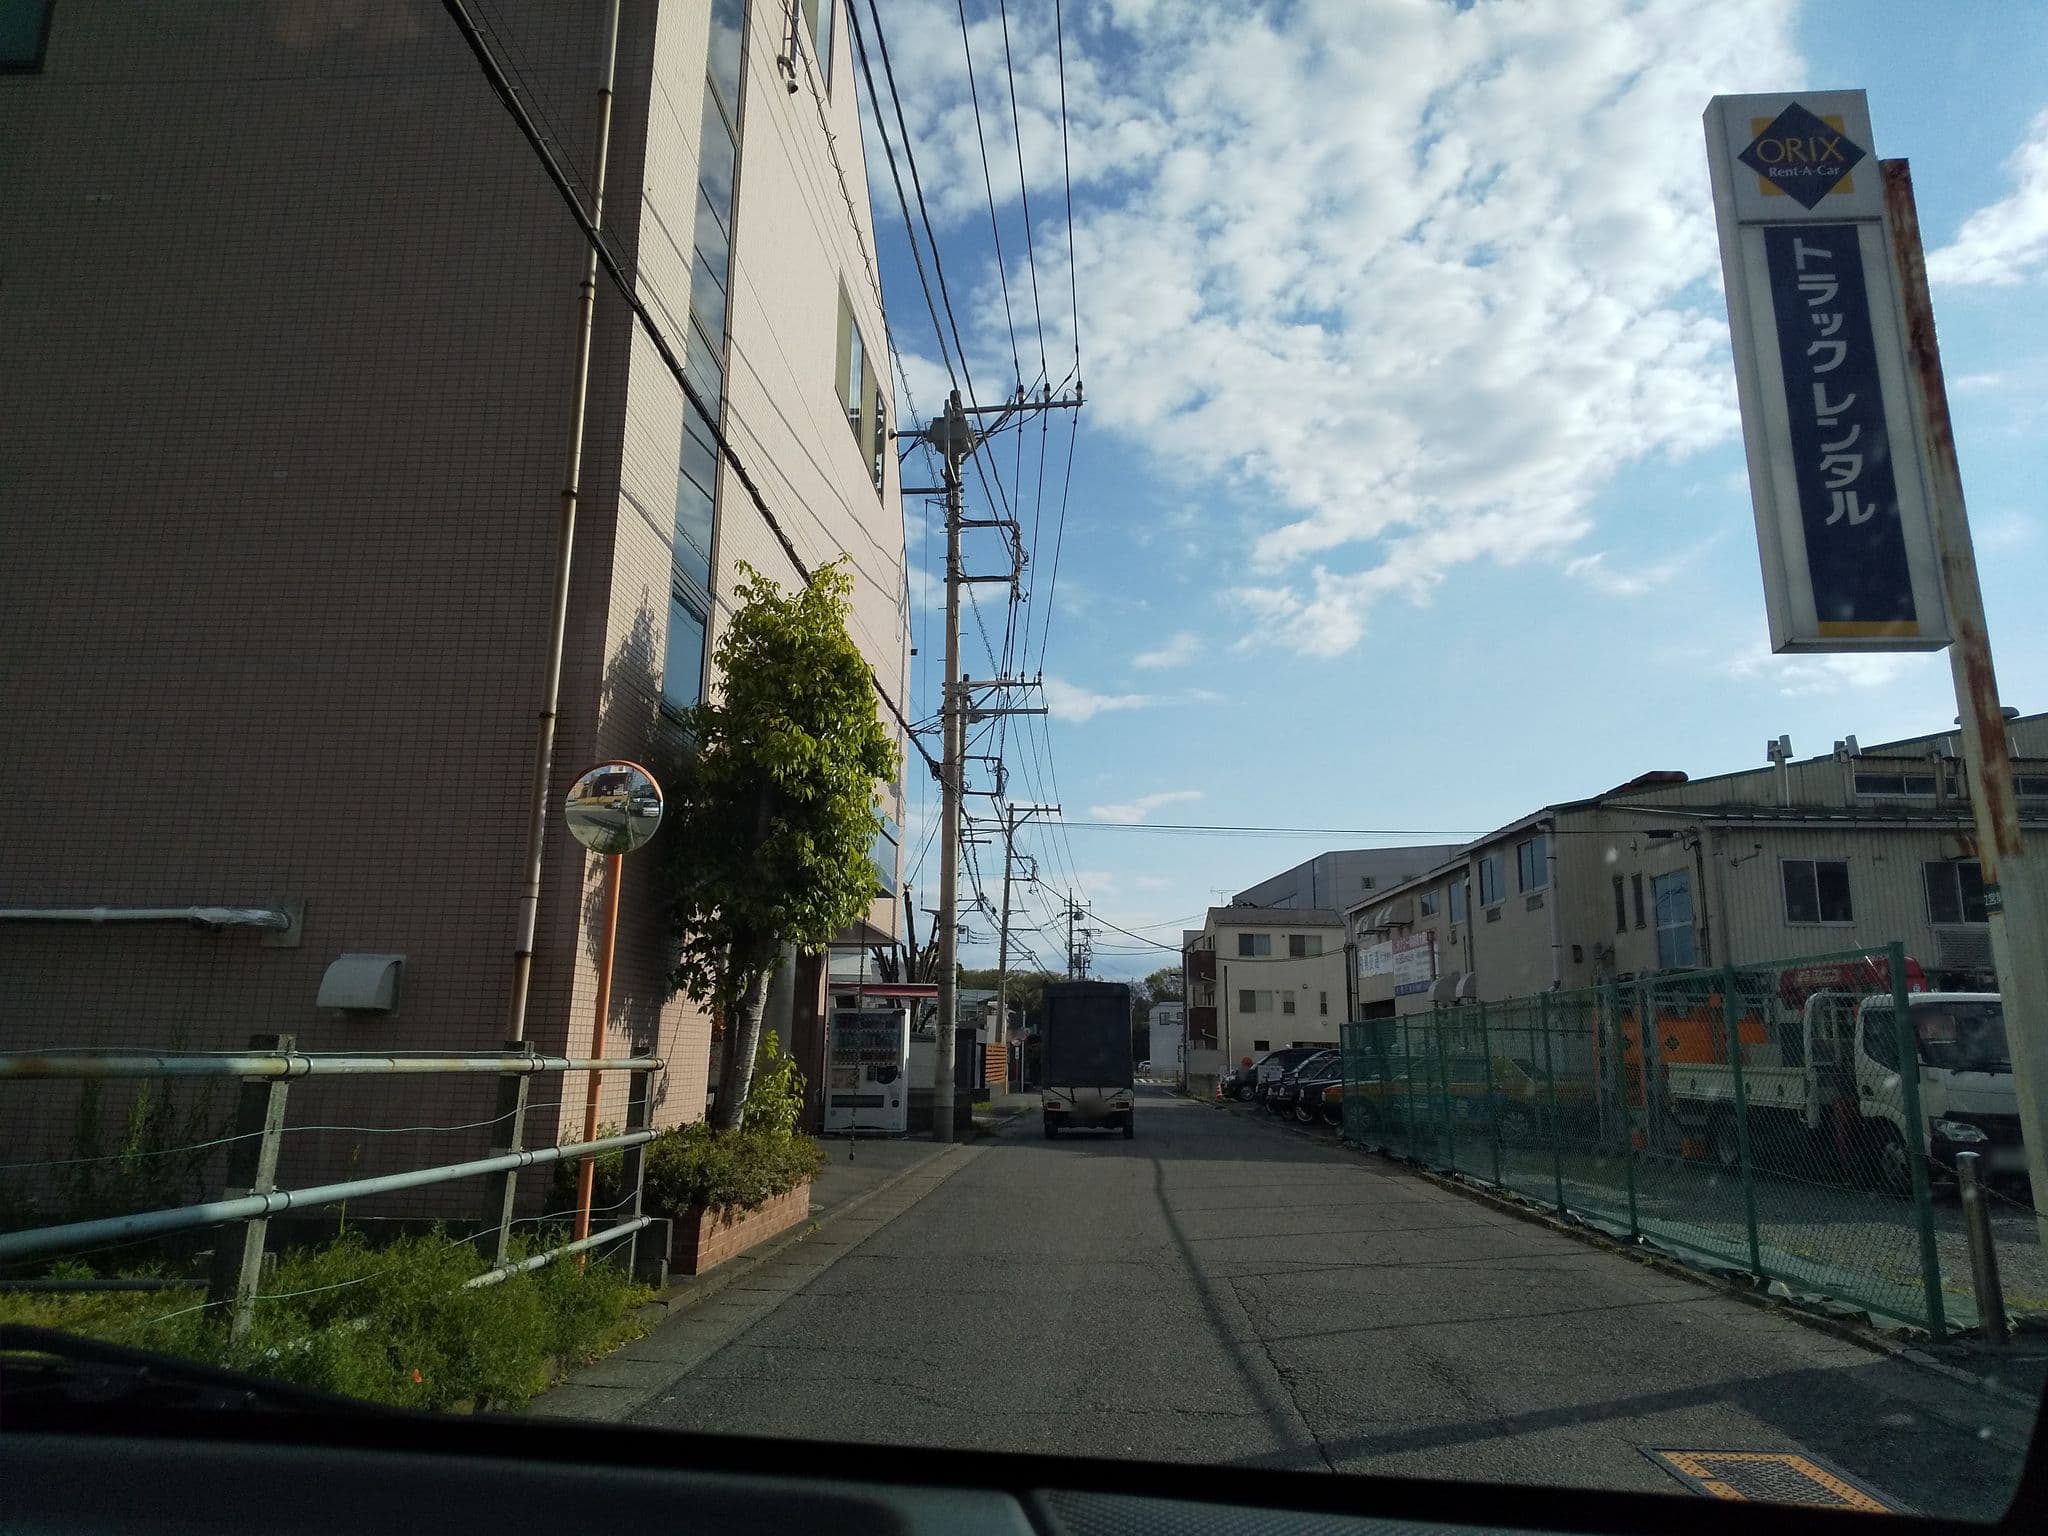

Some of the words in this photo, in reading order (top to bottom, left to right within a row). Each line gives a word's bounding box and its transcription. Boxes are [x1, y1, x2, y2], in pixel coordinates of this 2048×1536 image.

[1756, 136, 1844, 164] ORIX
[1769, 165, 1840, 177] Rent-A-Car
[1793, 236, 1876, 527] トラックレンタル
